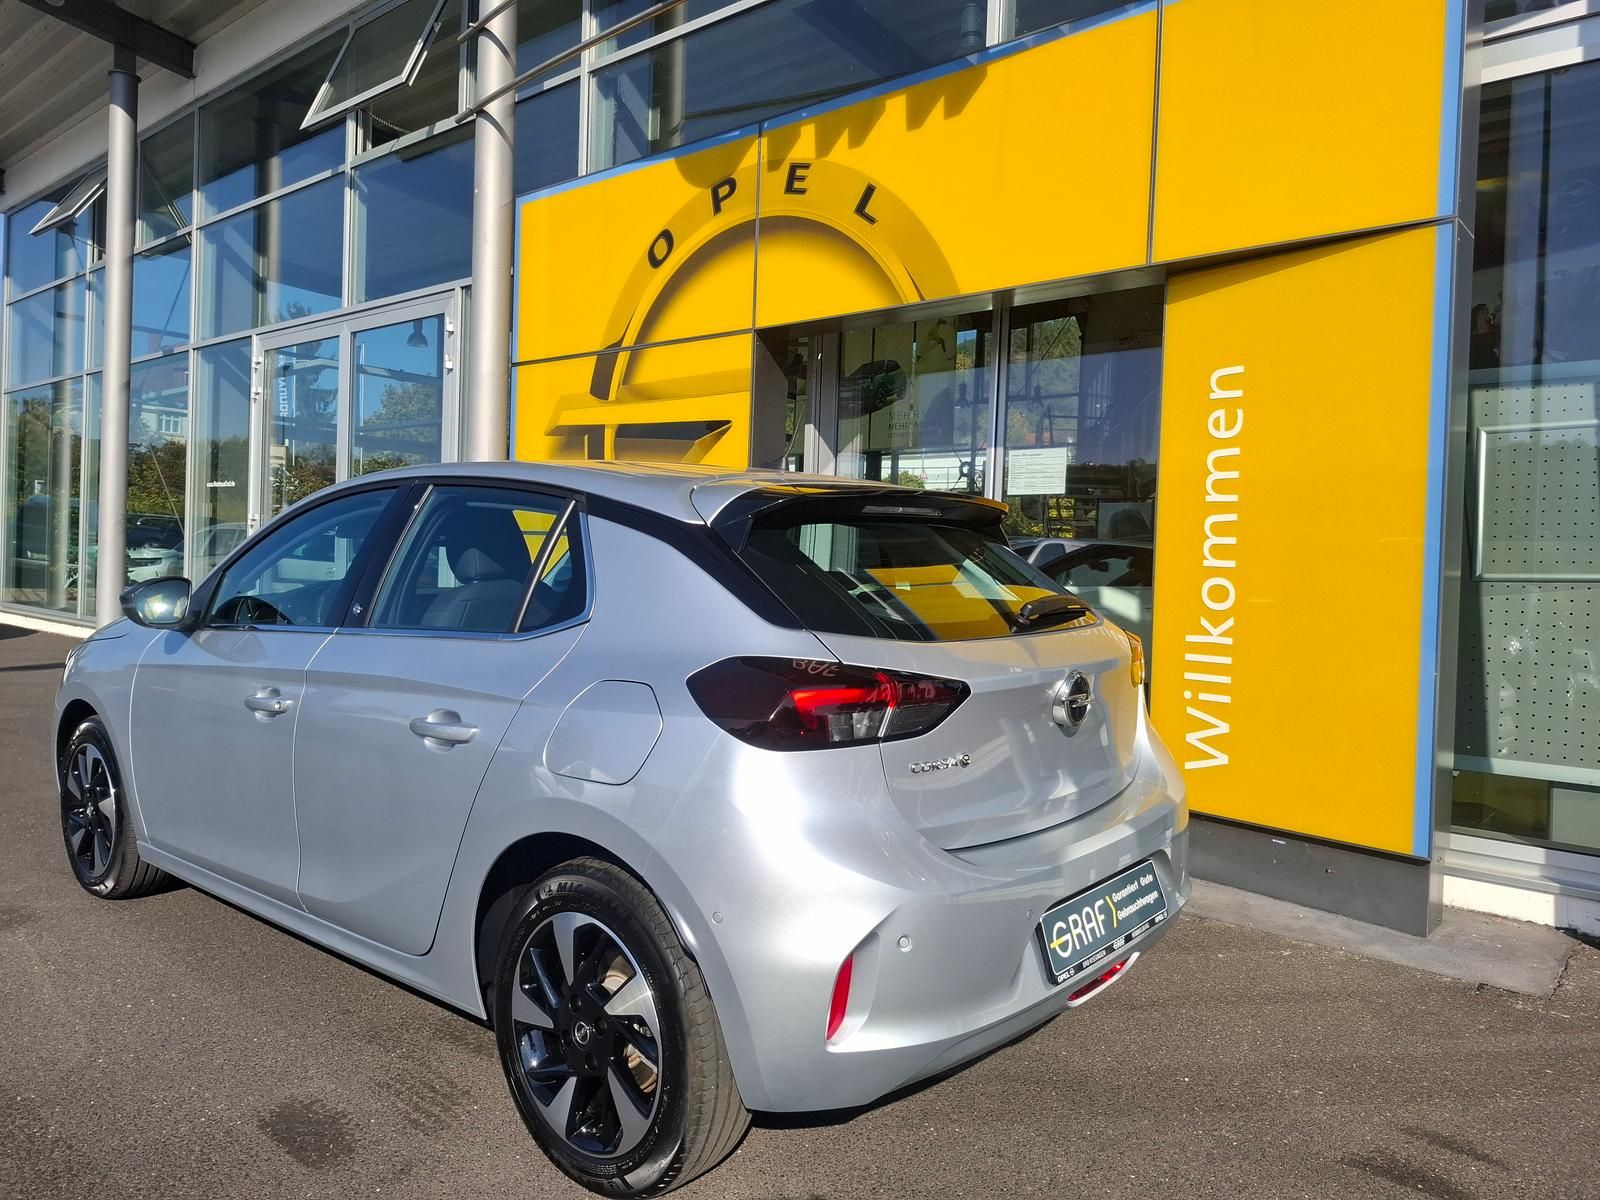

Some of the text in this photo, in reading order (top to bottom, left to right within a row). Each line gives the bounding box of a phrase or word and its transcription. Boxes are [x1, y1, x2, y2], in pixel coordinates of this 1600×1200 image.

[647, 162, 879, 269] OPEL
[1184, 364, 1245, 770] Willkommen
[1112, 874, 1153, 902] Garantiert Gute
[1117, 891, 1158, 920] Gebrauchtwagen
[1050, 899, 1104, 958] GRAF
